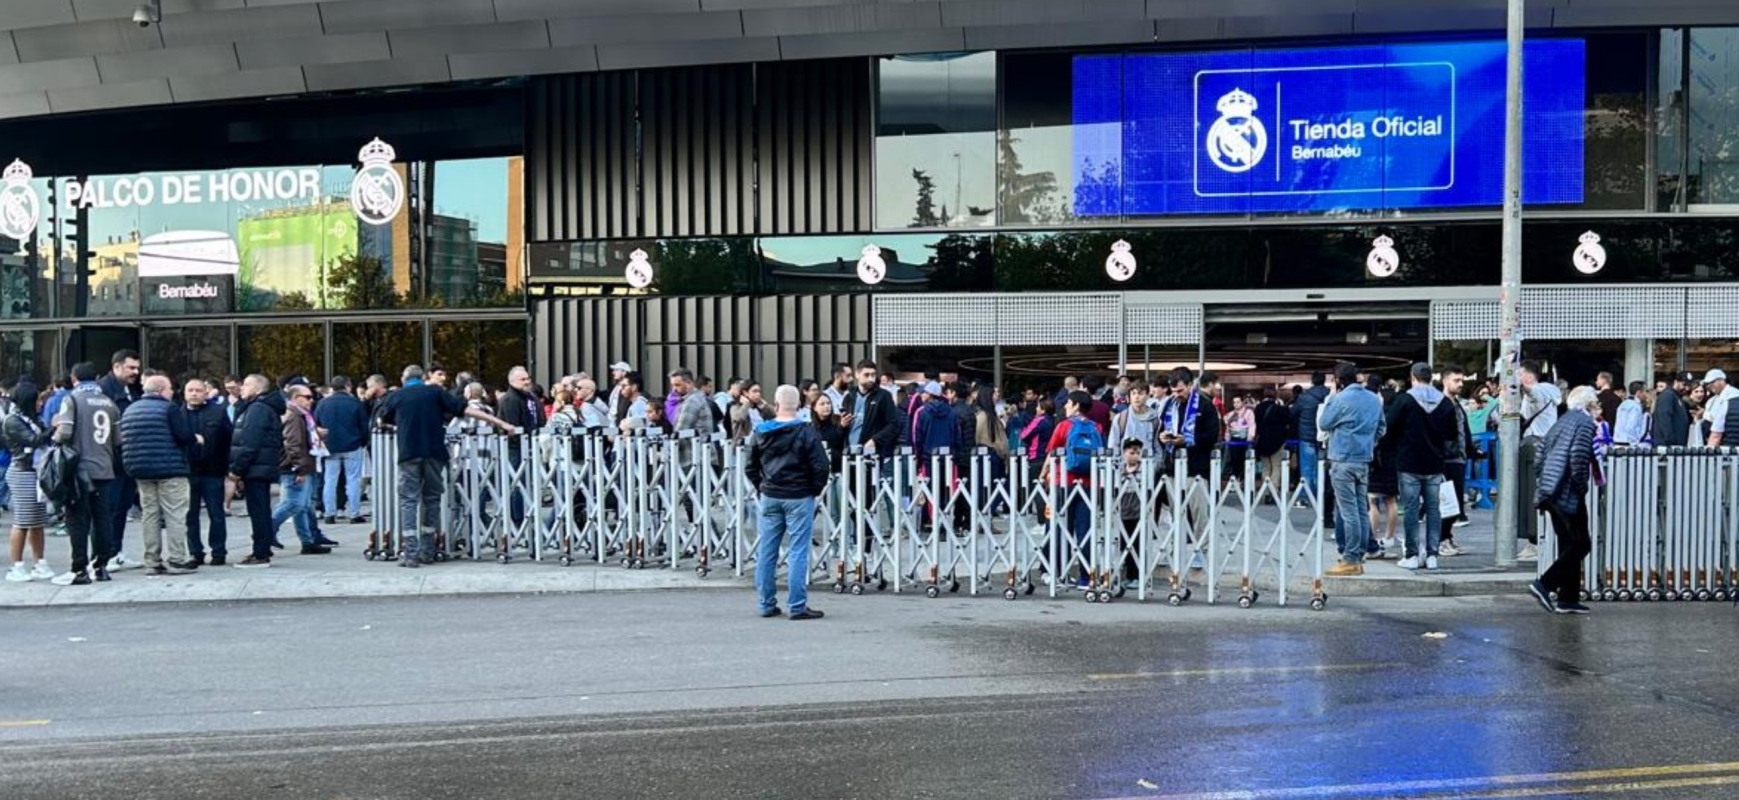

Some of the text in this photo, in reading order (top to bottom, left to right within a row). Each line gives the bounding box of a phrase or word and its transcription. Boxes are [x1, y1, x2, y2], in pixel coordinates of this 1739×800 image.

[1289, 115, 1442, 141] Tienda Oficial
[1291, 144, 1362, 159] Bernabéu
[65, 169, 320, 209] PALCO DE HONOR
[159, 282, 218, 299] Bernabéu
[93, 410, 111, 445] 9
